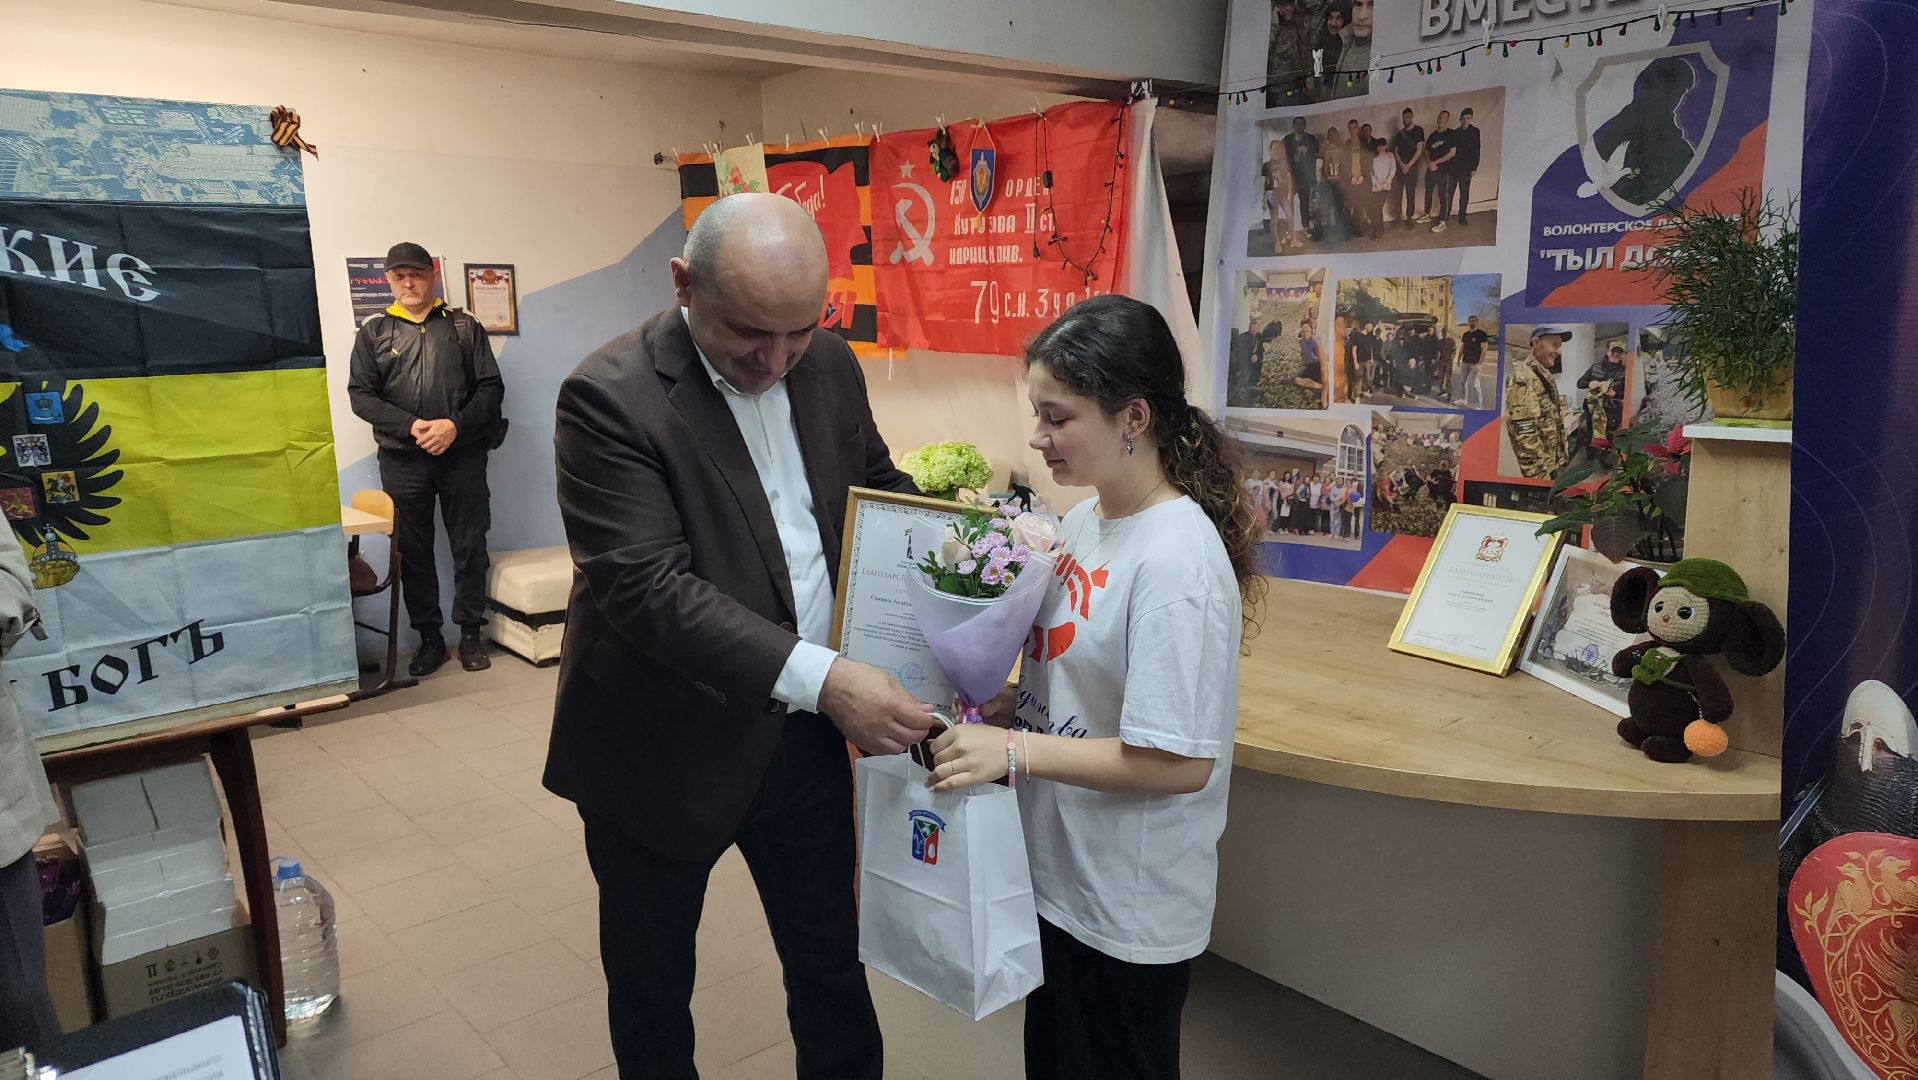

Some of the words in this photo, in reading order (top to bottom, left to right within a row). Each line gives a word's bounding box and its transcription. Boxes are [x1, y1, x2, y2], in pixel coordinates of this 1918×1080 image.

[1543, 218, 1653, 237] ВОЛОНТЕРСКОЕ
[970, 280, 1000, 325] 79
[41, 618, 225, 713] БОГЪ
